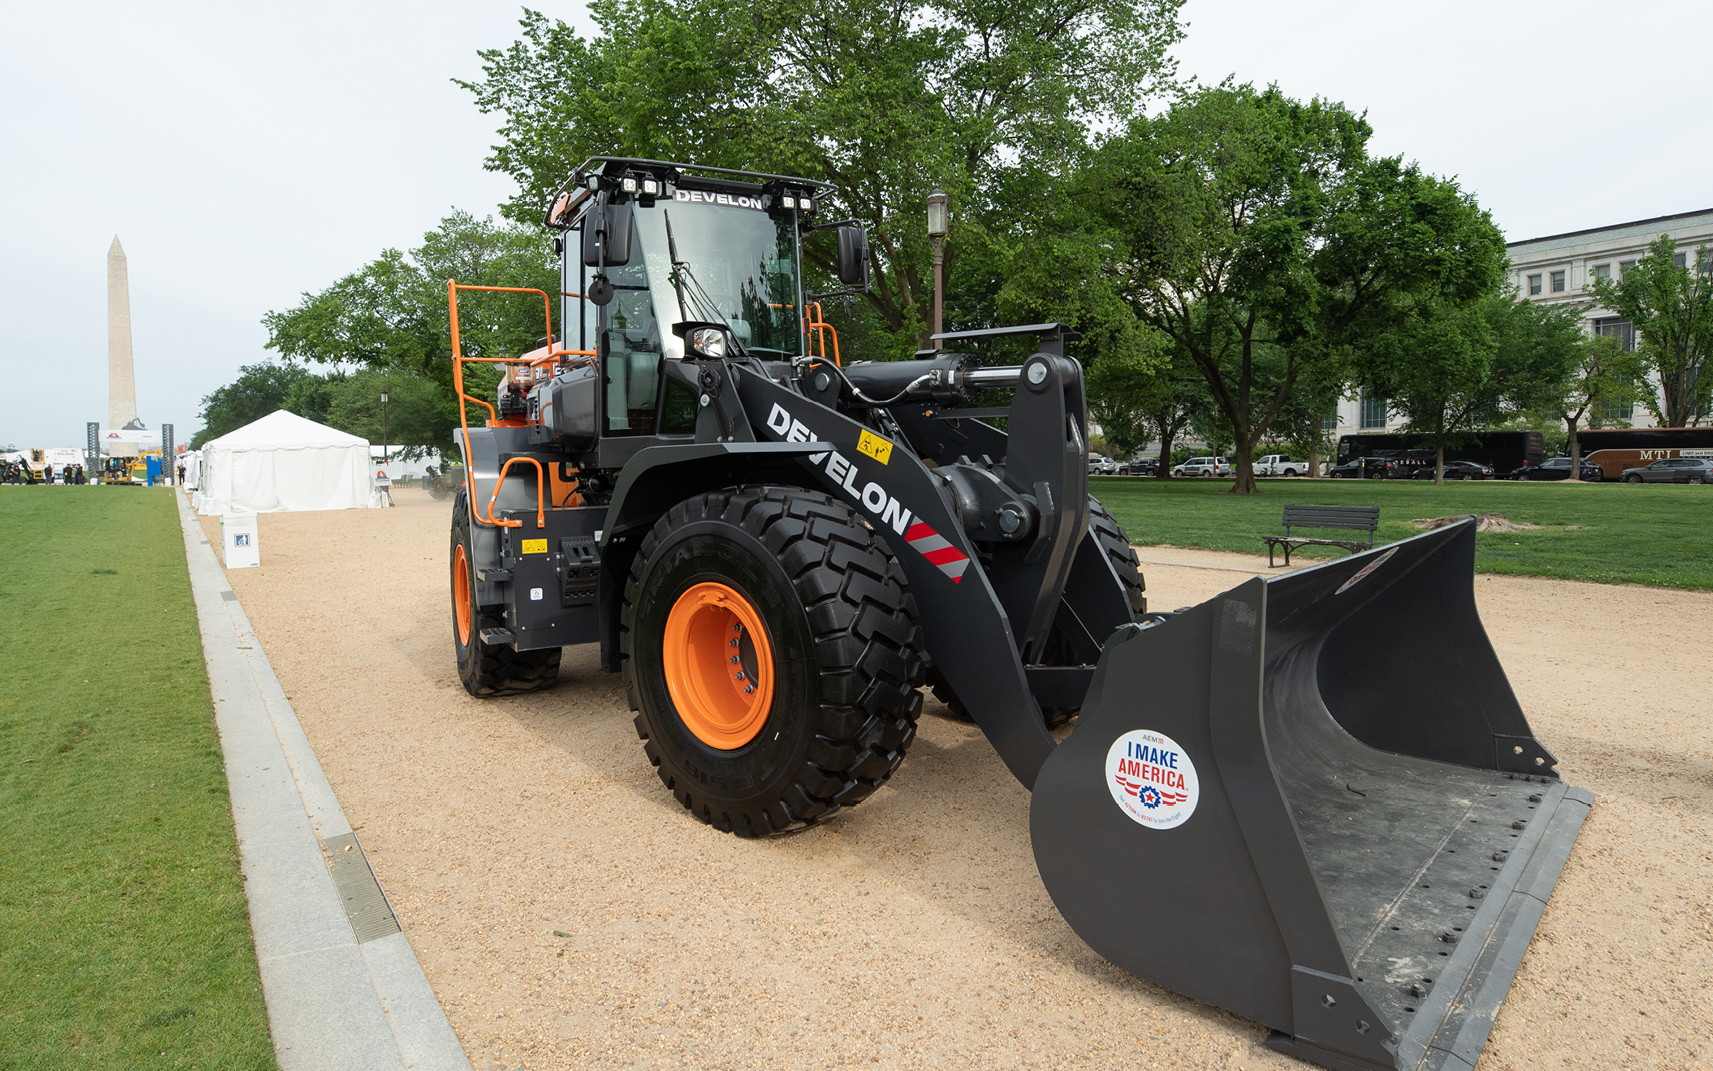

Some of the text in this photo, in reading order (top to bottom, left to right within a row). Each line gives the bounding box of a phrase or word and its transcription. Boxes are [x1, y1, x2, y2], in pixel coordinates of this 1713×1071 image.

[675, 190, 763, 210] DEVELON
[766, 402, 912, 536] DEVELON
[1639, 450, 1672, 460] MTI
[641, 539, 783, 619] TRIANGLE
[1142, 734, 1158, 743] AEM
[1127, 741, 1178, 770] I MAKE
[1118, 758, 1185, 791] AMERICA
